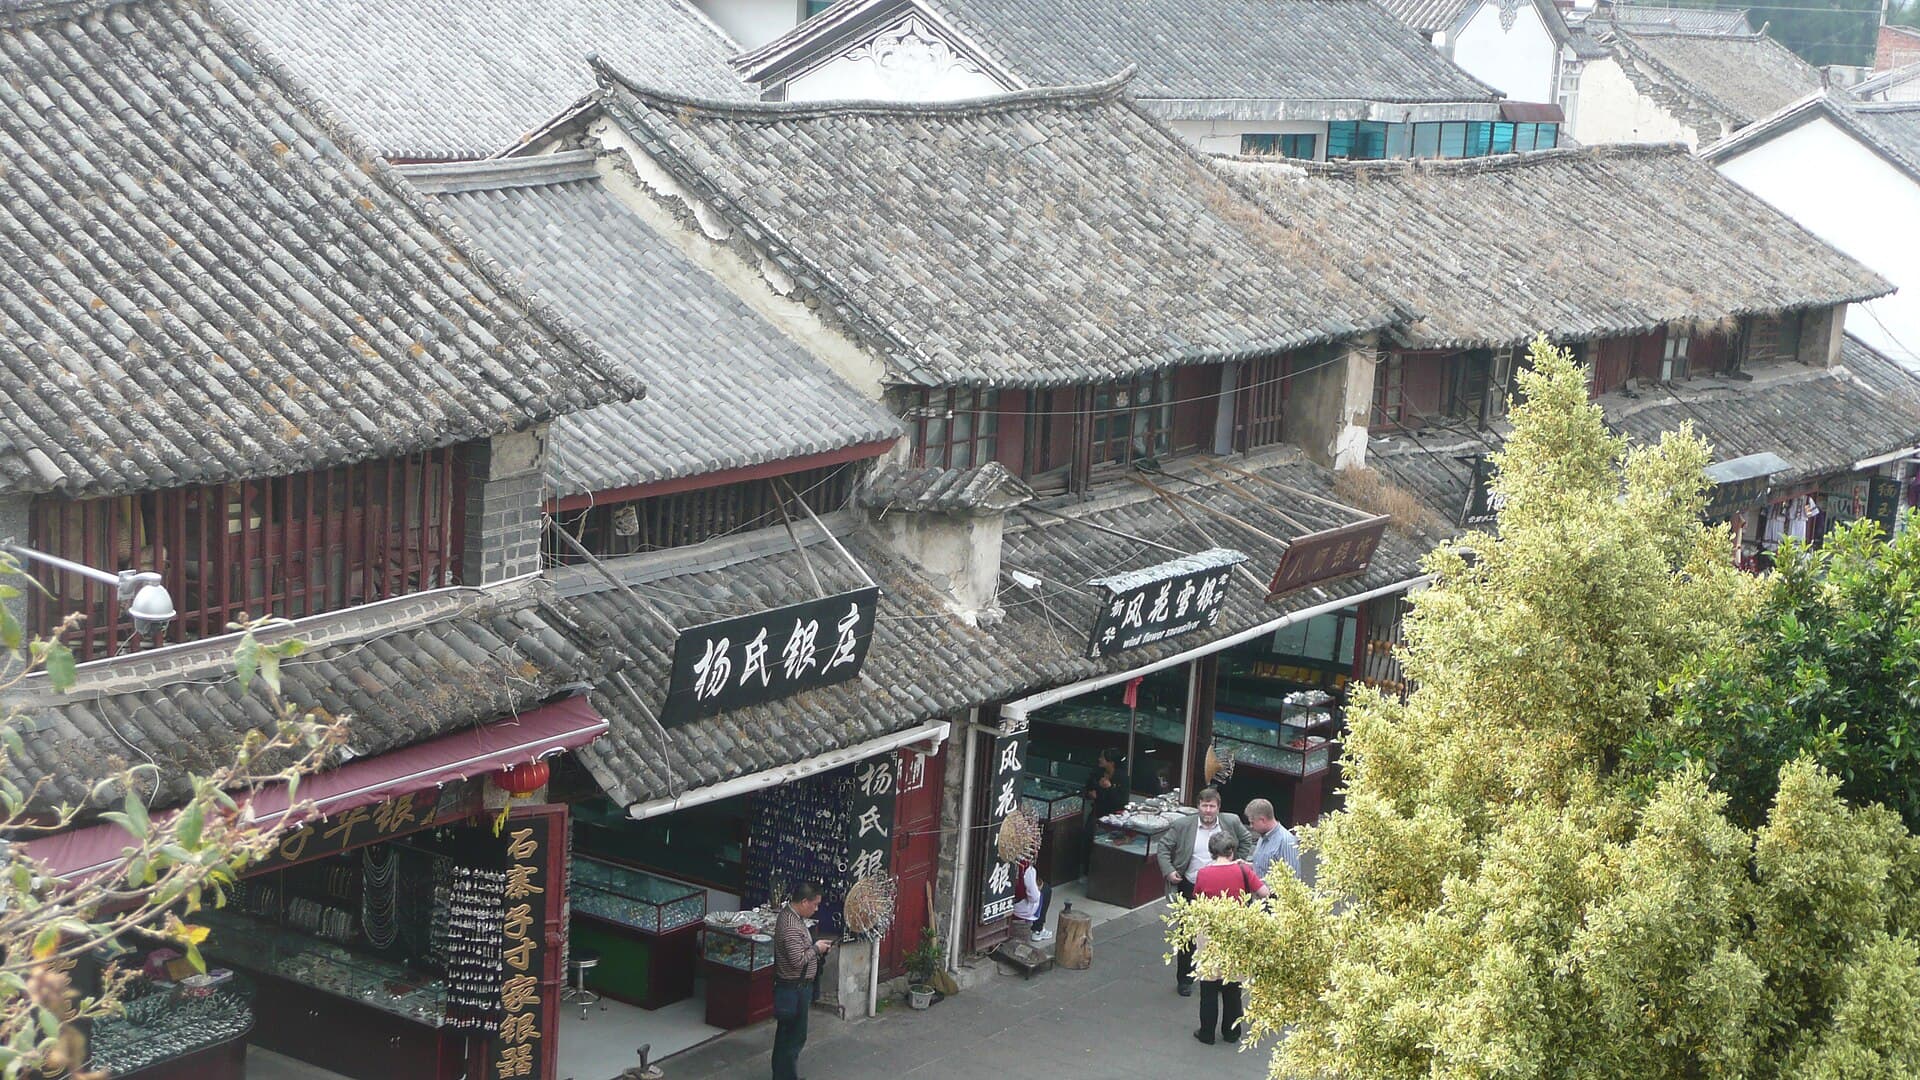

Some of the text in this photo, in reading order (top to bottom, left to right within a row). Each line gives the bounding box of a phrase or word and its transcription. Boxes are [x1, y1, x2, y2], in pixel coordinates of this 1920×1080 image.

[1119, 575, 1218, 630] 风花雪银
[1122, 633, 1143, 649] wind
[1141, 629, 1166, 644] flower
[692, 602, 862, 702] 杨氏银庄
[988, 739, 1023, 895] 风花银
